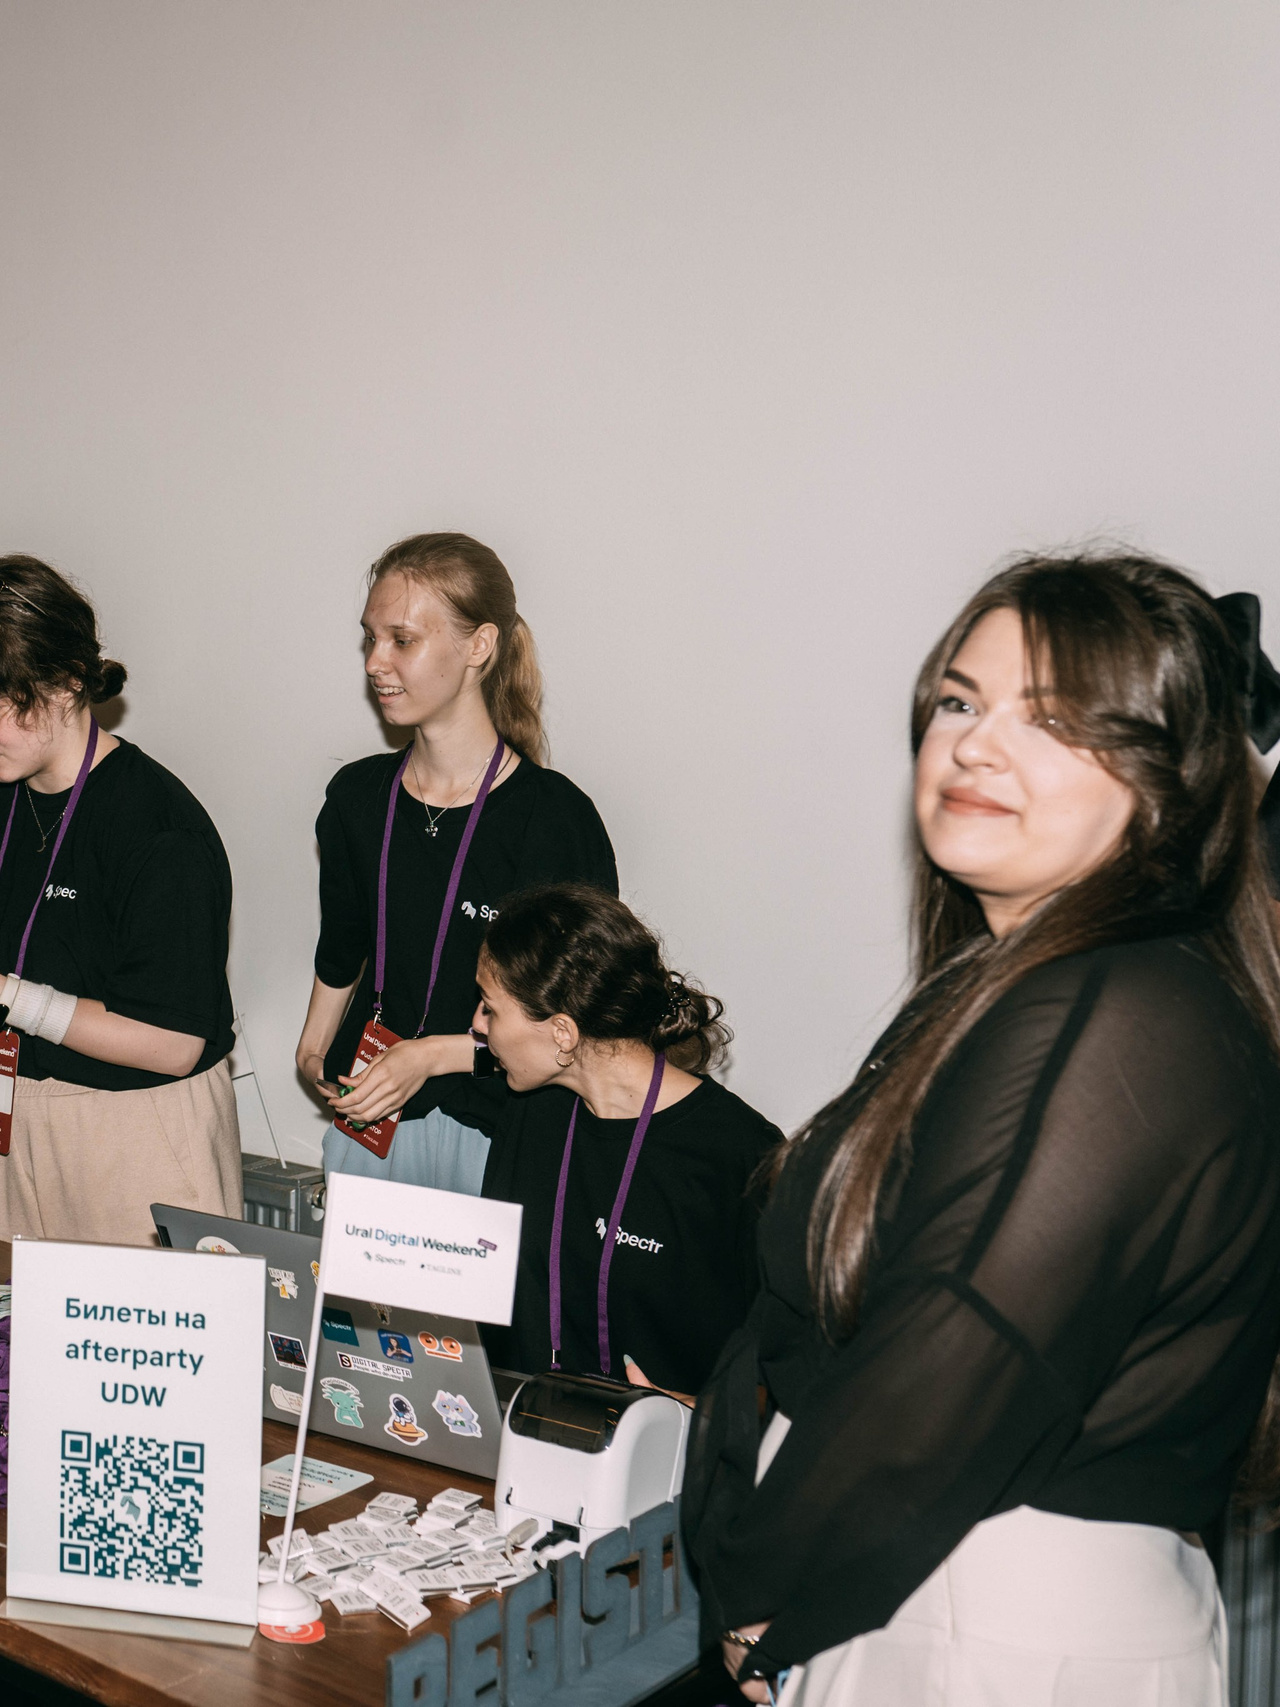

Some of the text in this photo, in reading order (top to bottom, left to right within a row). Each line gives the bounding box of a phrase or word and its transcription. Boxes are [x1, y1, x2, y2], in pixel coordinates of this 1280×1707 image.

[363, 1031, 375, 1044] Ural
[345, 1223, 373, 1239] Ural
[374, 1228, 420, 1247] Digital
[421, 1237, 488, 1258] Weekend
[375, 1253, 406, 1266] Spectr
[65, 1297, 206, 1330] Билеты на
[65, 1339, 205, 1376] afterparty
[351, 1356, 380, 1370] DIGITAL
[101, 1381, 167, 1408] UDW
